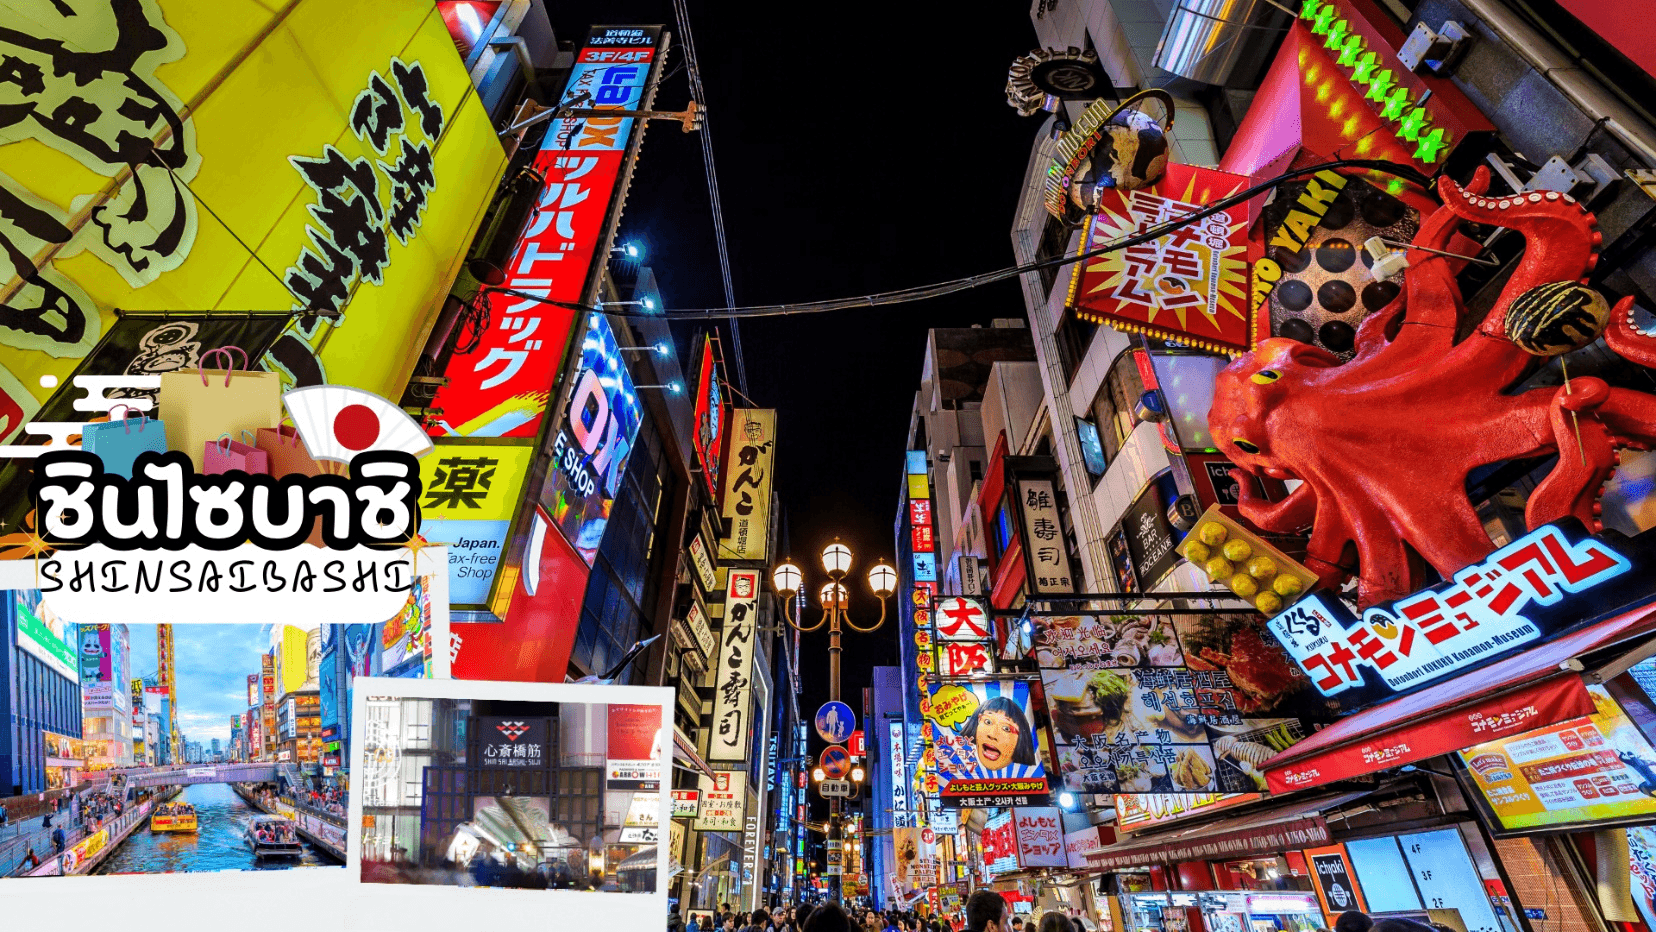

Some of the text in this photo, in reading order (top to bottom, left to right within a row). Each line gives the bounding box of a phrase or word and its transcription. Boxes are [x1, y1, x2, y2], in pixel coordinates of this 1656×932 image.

[585, 51, 650, 62] 3F/4F
[1056, 97, 1112, 164] MUSEUM
[1269, 169, 1348, 254] YAKI
[473, 157, 599, 390] ツルハドラッグ
[422, 456, 499, 510] 薬
[564, 449, 595, 498] SHOP
[732, 440, 773, 517] がんこ
[453, 537, 501, 551] Japan.
[1143, 529, 1158, 550] BAR
[458, 566, 493, 581] Shop
[1284, 607, 1320, 637] くくる
[1301, 532, 1620, 691] コナモンミュージアム
[937, 597, 992, 677] 大阪
[1052, 643, 1112, 659] 어서오세요
[1388, 623, 1535, 688] Dotonbori KUKURU Konamon-Museum
[719, 601, 755, 747] がんこ寿司
[934, 692, 968, 715] おみやげ
[1140, 688, 1237, 711] 해선호프집
[1471, 706, 1539, 733] コナモンミュージアム
[484, 743, 541, 758] 心斎橋筋
[935, 736, 975, 747] よしもと
[1072, 729, 1172, 752] 大阪名产物
[937, 747, 976, 760] エンタメ
[767, 737, 778, 792] TSUTAYA
[939, 761, 979, 774] ショップ
[822, 783, 849, 793] 自動車
[949, 781, 1044, 793] よしもと芸人グッズ・大阪みやげ
[1019, 816, 1056, 828] よしもと
[743, 816, 757, 870] FOREVER
[923, 832, 933, 840] 2F
[1020, 829, 1059, 841] エンタメ
[1022, 842, 1061, 856] ショップ
[1411, 844, 1421, 854] 4F
[1421, 870, 1432, 881] 3F
[1432, 898, 1443, 908] 2F
